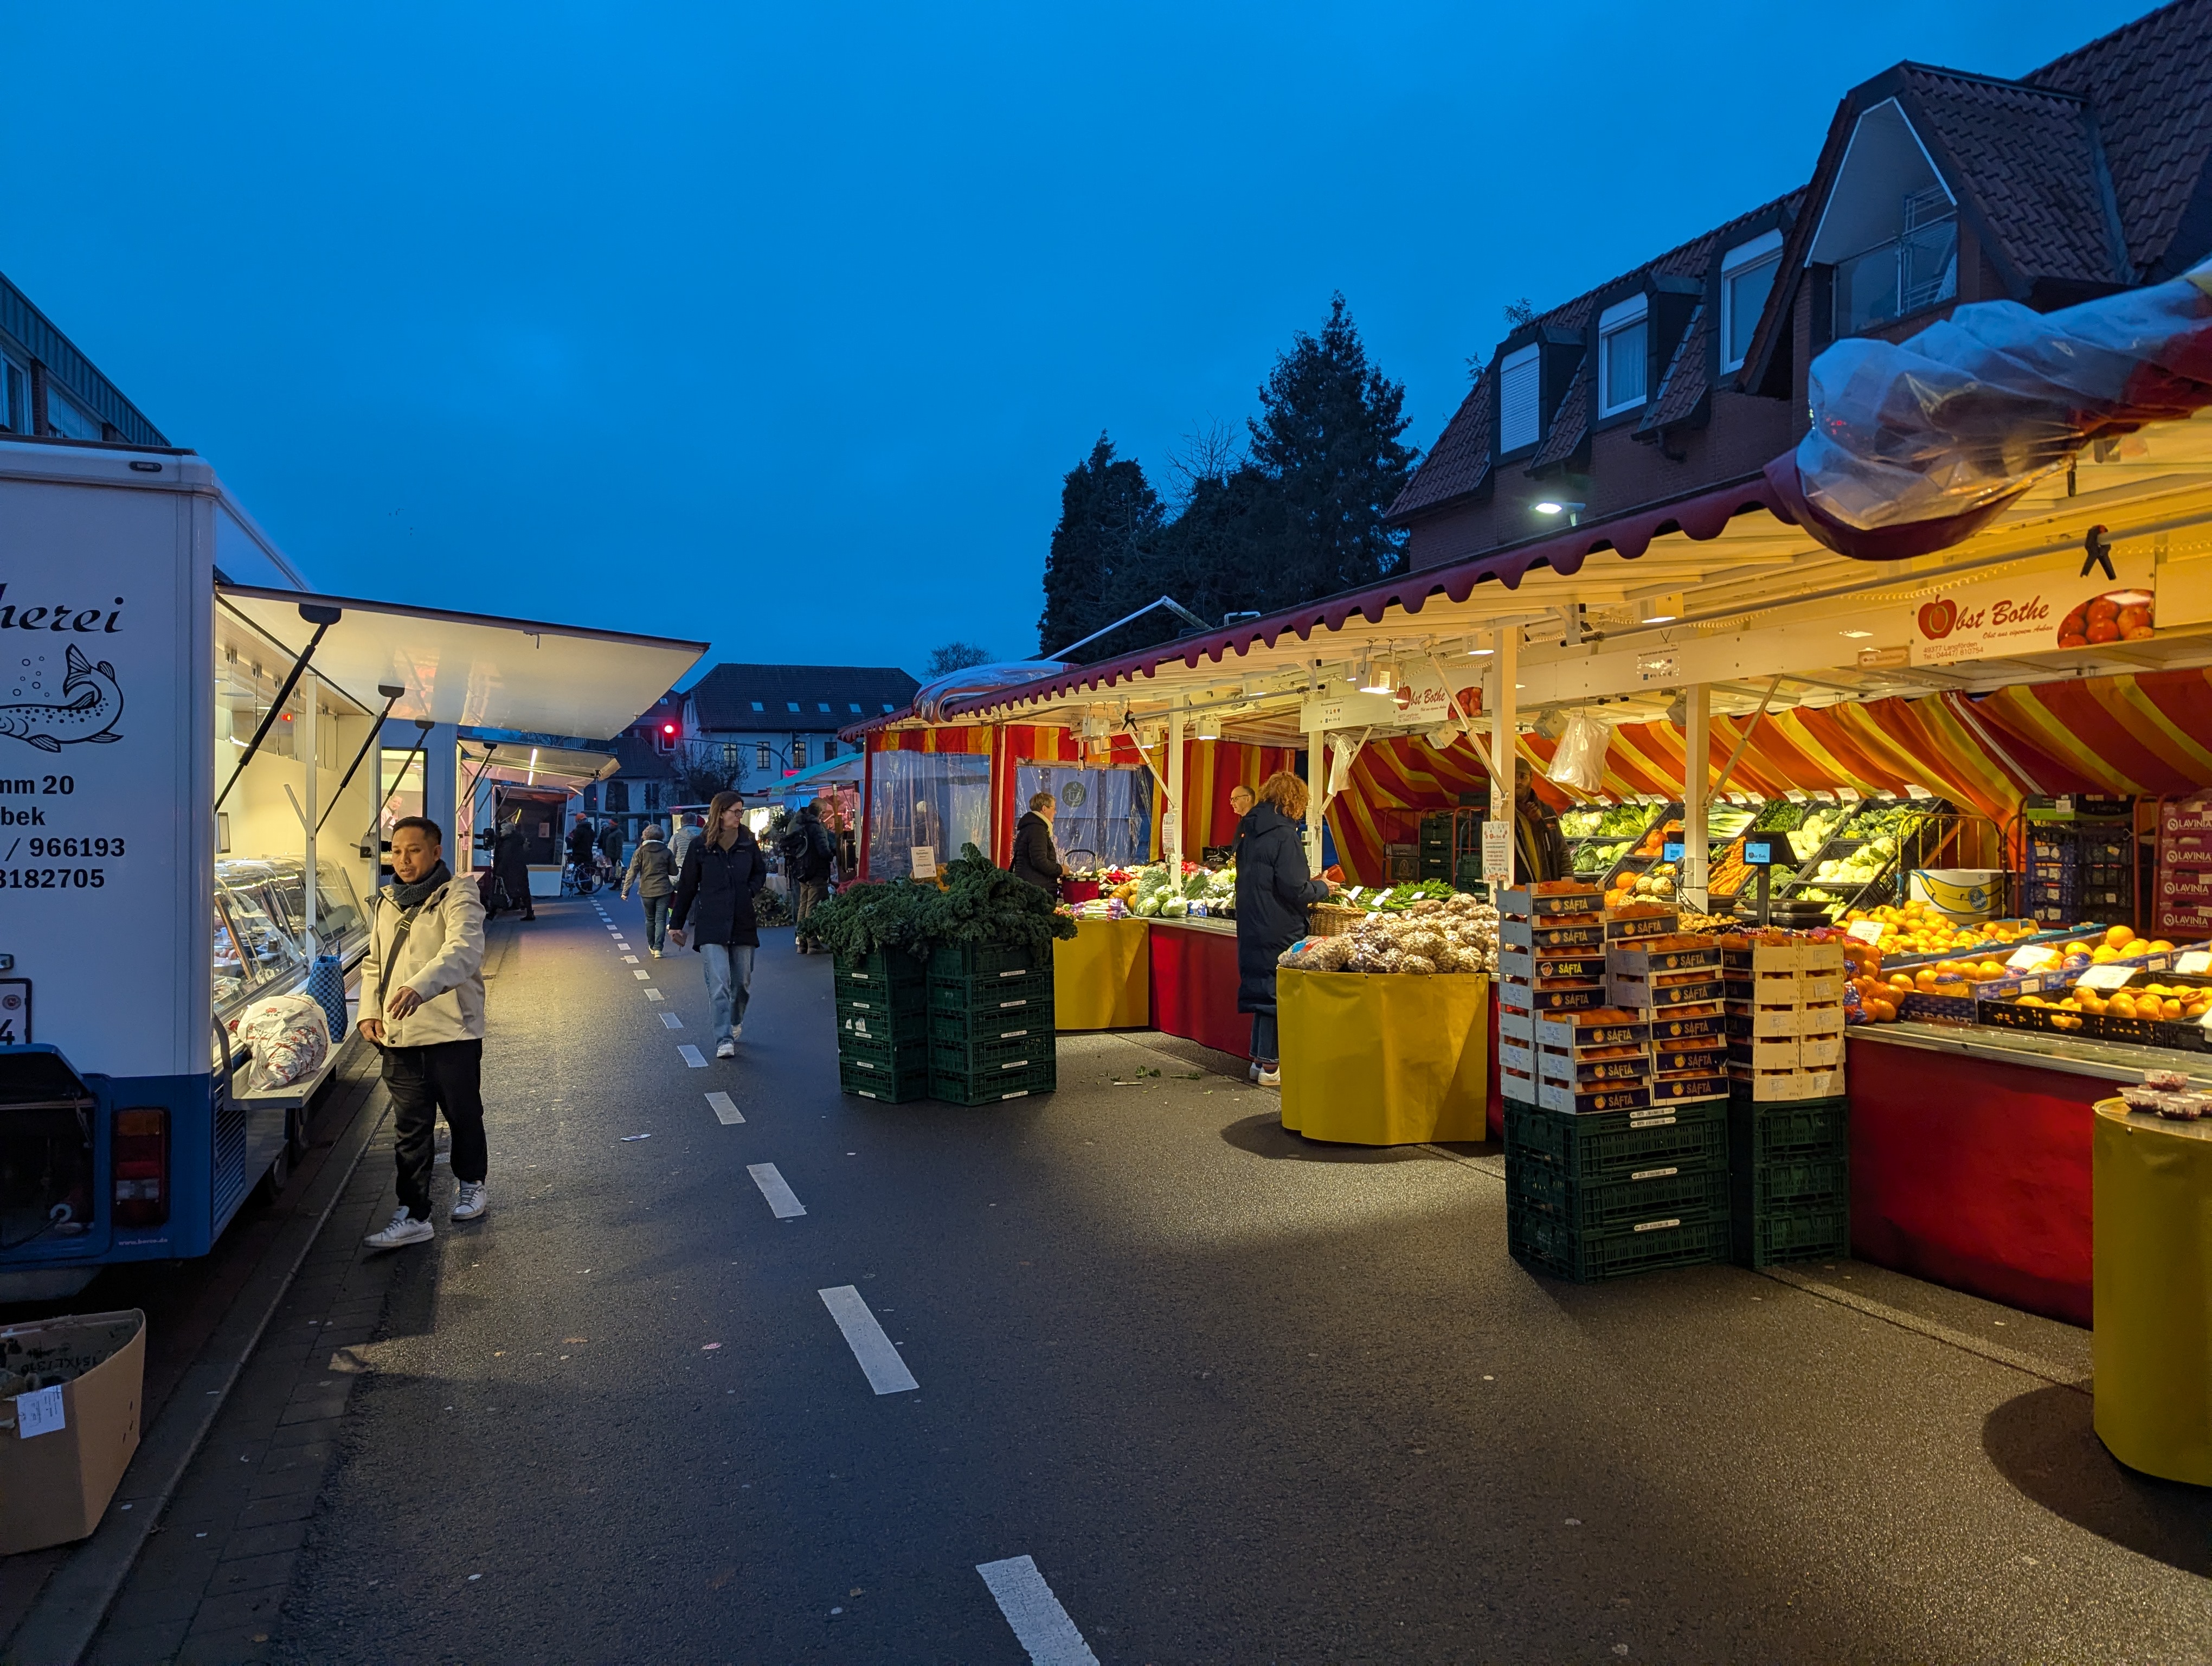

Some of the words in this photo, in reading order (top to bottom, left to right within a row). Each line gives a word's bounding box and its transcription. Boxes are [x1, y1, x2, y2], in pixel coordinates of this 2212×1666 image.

[1921, 599, 1985, 637] Obst
[1992, 595, 2049, 625] Bothe
[1944, 642, 1978, 651] Langförden
[1424, 687, 1445, 704] Bothe
[42, 775, 74, 795] 20
[1, 806, 46, 826] bek
[2178, 819, 2212, 828] LAVINIA
[29, 837, 125, 857] 966193
[2178, 851, 2211, 861] LAVINIA
[2175, 883, 2209, 893] LAVINIA
[1564, 898, 1589, 912] SAFTA
[1637, 919, 1662, 934] SAFTA
[2175, 915, 2208, 925] LAVINIA
[1563, 930, 1588, 944] SAFTA
[1680, 952, 1706, 967] SAFTA
[1558, 962, 1583, 976] SAFTA
[1565, 992, 1590, 1007] SAFTA
[1683, 985, 1708, 1001] SAFTA
[1607, 1028, 1632, 1042] SAFTA
[1684, 1020, 1709, 1035] SAFTA
[1687, 1053, 1712, 1068] SAFTA
[1608, 1062, 1634, 1078] SAFTA
[1687, 1080, 1712, 1095] SAFTA
[1608, 1092, 1634, 1108] SAFTA
